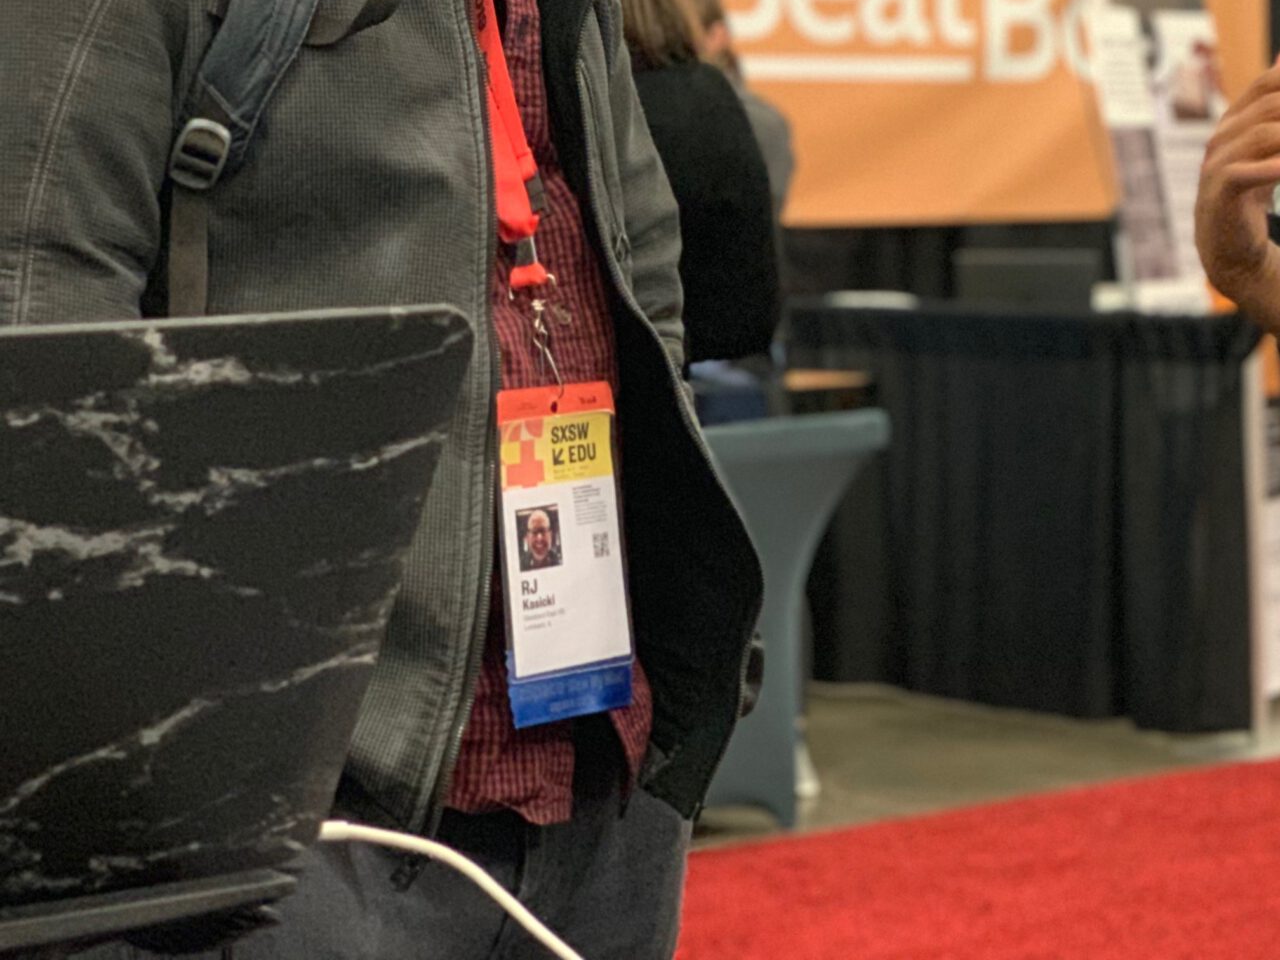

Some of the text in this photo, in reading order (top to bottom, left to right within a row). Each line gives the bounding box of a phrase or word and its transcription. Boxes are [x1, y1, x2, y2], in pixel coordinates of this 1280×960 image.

[551, 421, 590, 445] SXSW
[568, 442, 597, 464] EDU
[521, 578, 539, 596] RJ
